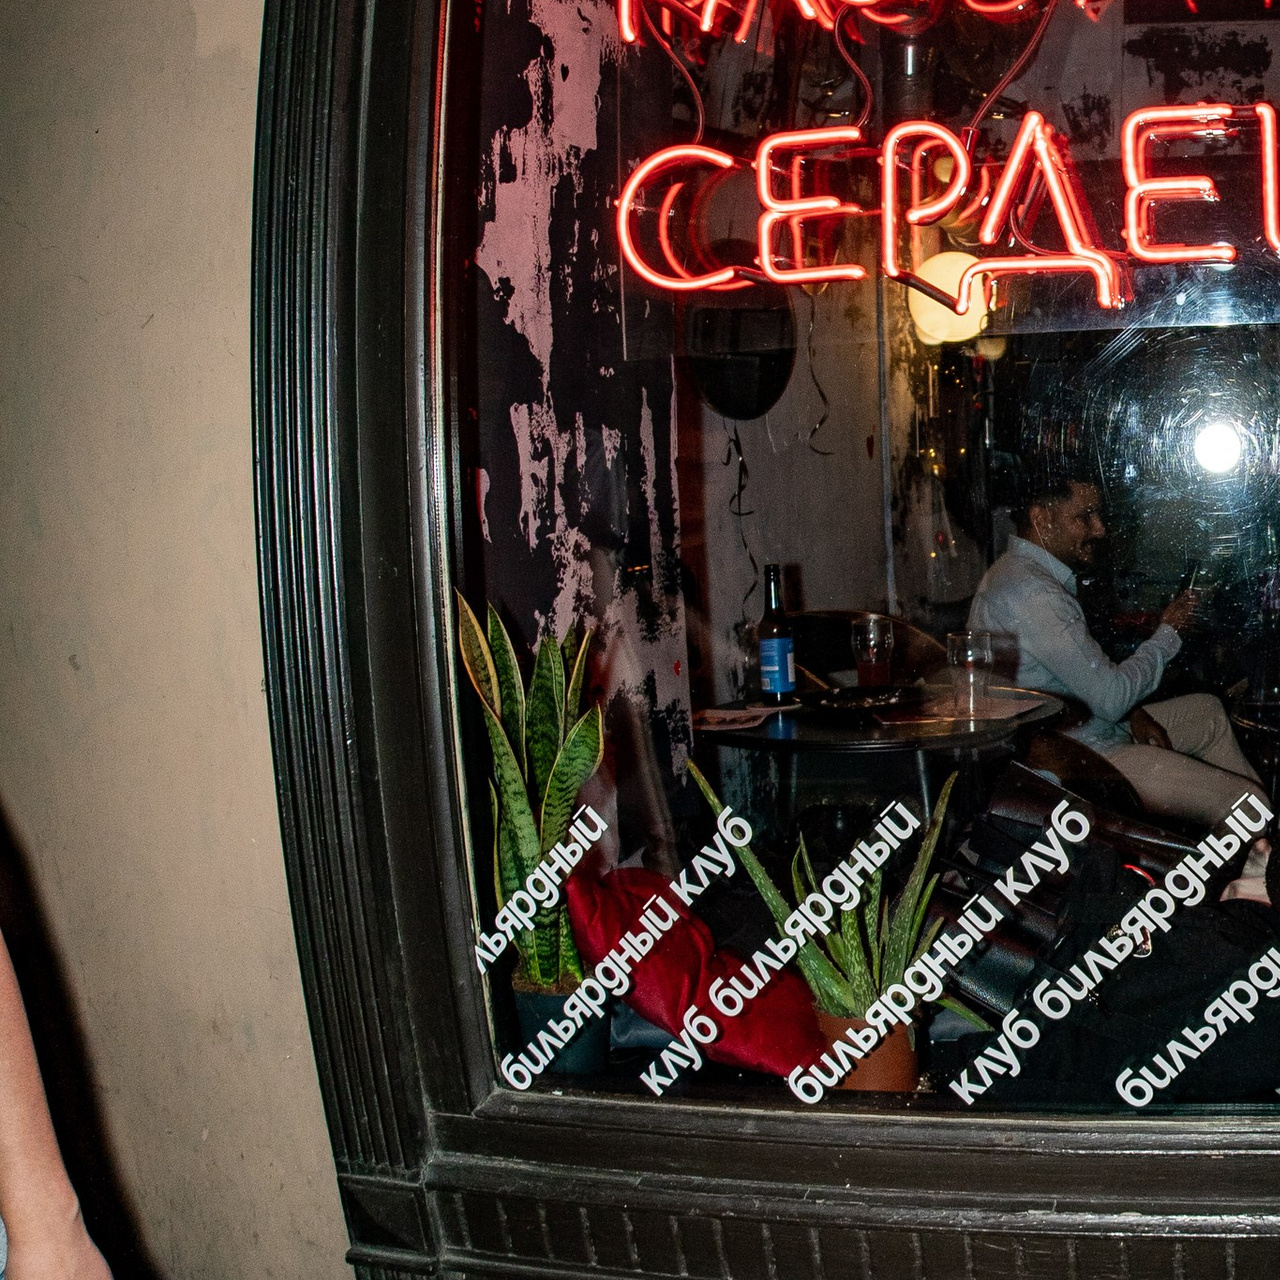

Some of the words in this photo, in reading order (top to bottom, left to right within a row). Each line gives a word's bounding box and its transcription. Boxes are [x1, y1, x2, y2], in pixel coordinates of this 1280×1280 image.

[500, 894, 680, 1090] бильярдный
[669, 805, 753, 907] клуб
[639, 1004, 718, 1096] клуб
[708, 801, 921, 1017] бильярдный
[788, 893, 1004, 1104] бильярдный
[993, 799, 1090, 906] клуб
[948, 1008, 1040, 1105] клуб
[1032, 792, 1275, 1019] бильярдный
